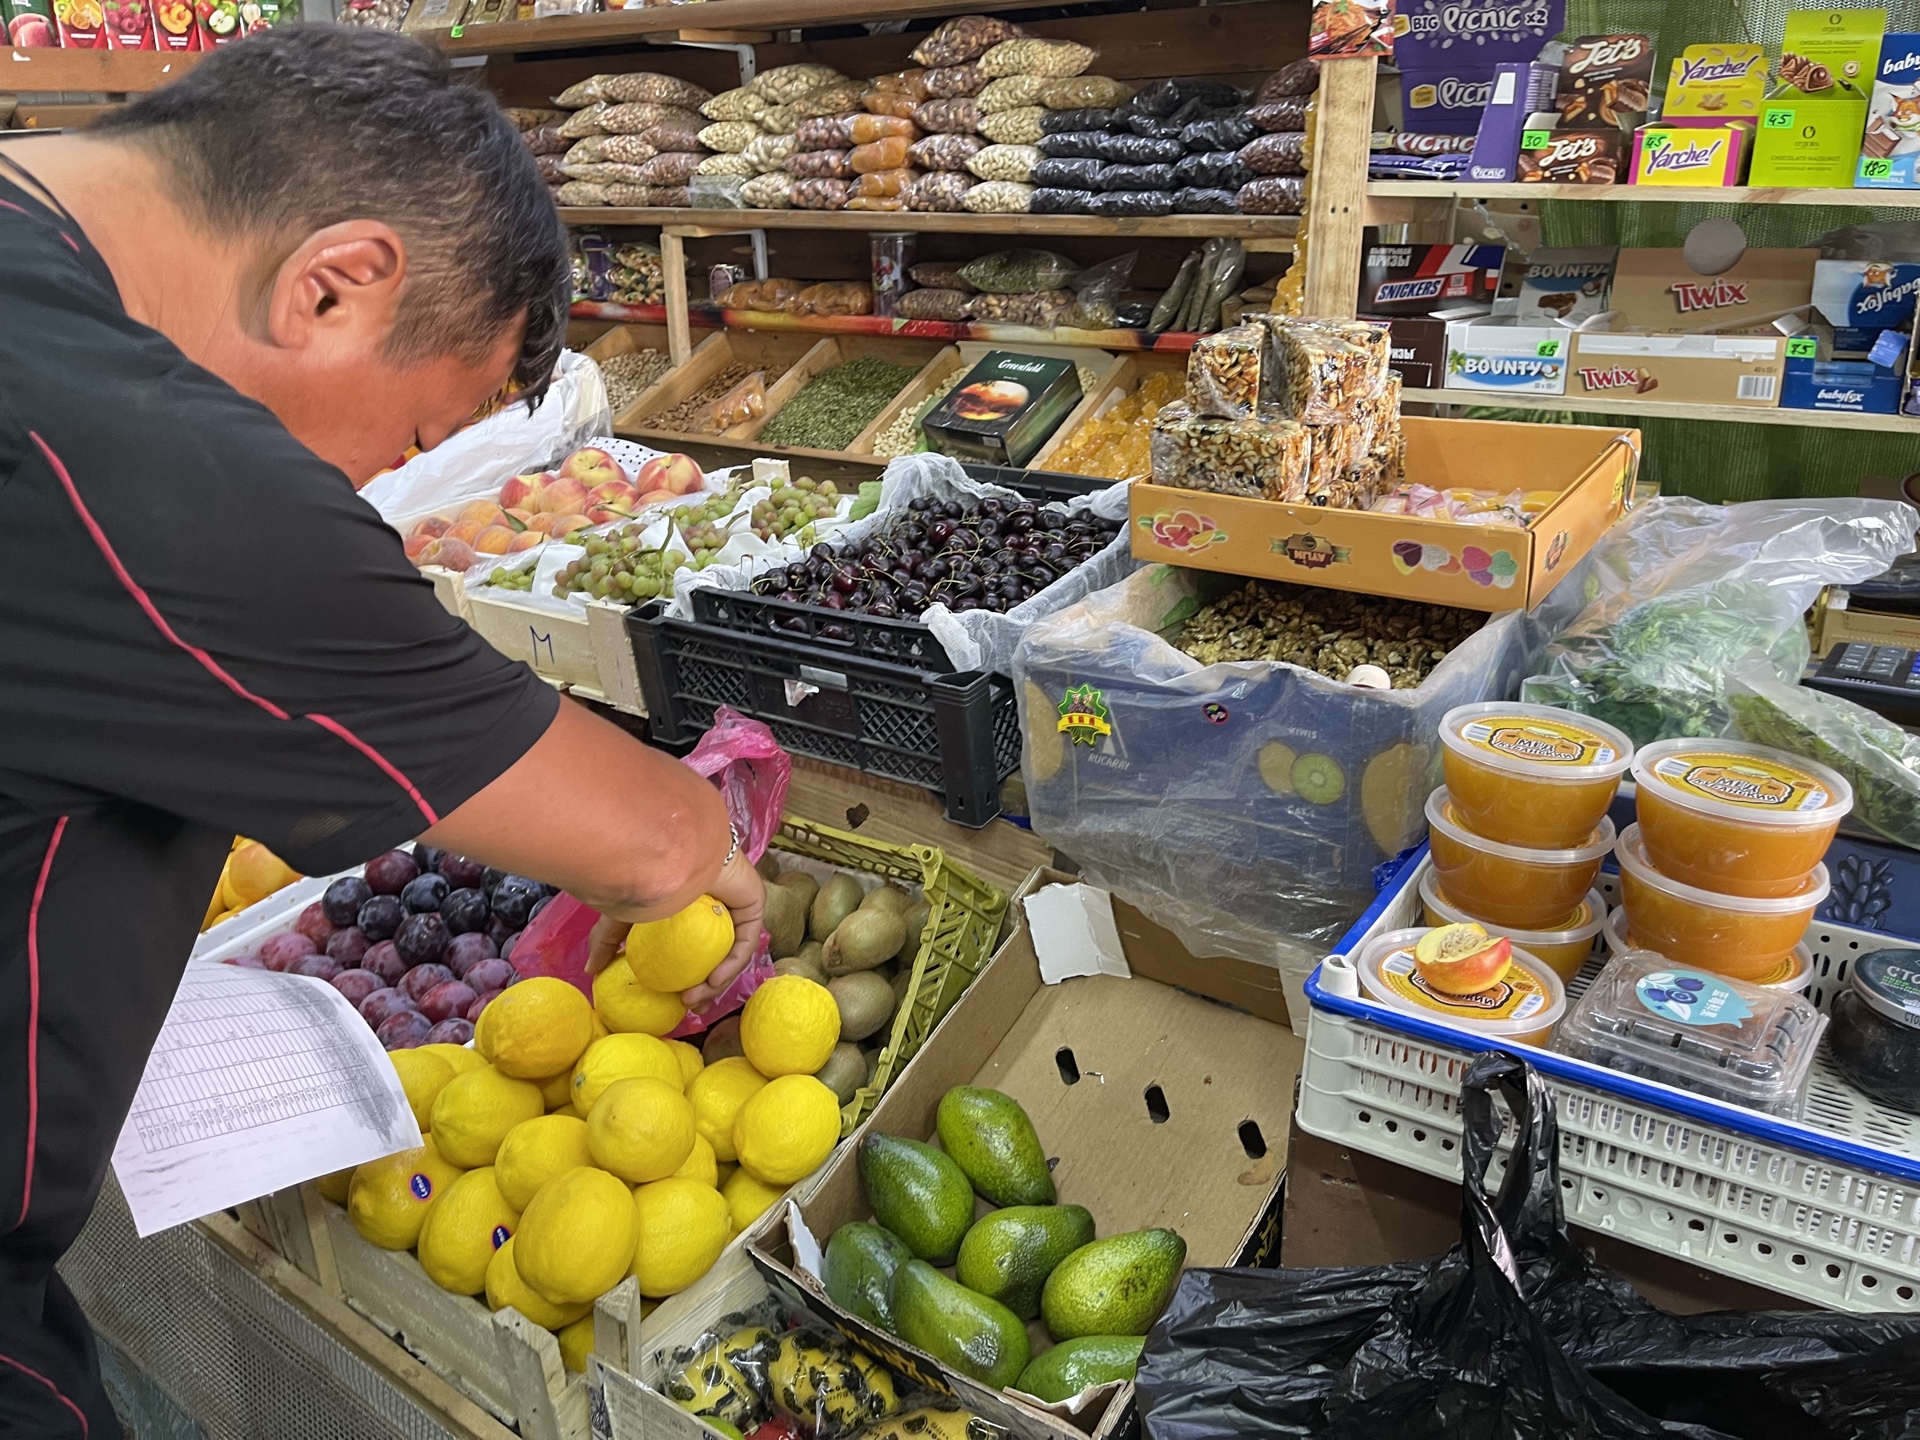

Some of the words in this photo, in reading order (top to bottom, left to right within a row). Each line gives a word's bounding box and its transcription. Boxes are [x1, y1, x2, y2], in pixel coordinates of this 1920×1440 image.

[1412, 16, 1440, 32] BIG
[1443, 5, 1522, 33] Picnic
[1569, 37, 1641, 74] Jet's
[1679, 55, 1759, 86] Yarche!
[1768, 113, 1791, 126] 45
[1524, 135, 1541, 147] 30
[1646, 135, 1667, 149] 45
[1538, 137, 1597, 167] Jet's
[1646, 140, 1722, 175] Yarche!
[1471, 165, 1506, 180] Picnic
[1864, 160, 1887, 176] 180
[1367, 255, 1412, 267] ПРИЗЫ
[1528, 264, 1605, 279] BOUNTY
[1377, 279, 1442, 301] SNICKERS
[1672, 278, 1748, 311] Twix
[1538, 343, 1559, 357] 85
[997, 359, 1046, 373] Greenfield
[1464, 357, 1543, 377] BOUNTY
[1580, 365, 1639, 390] Twix
[1816, 388, 1865, 403] babyfox
[1286, 727, 1318, 740] KIWIS
[1087, 753, 1131, 771] RUCARAY
